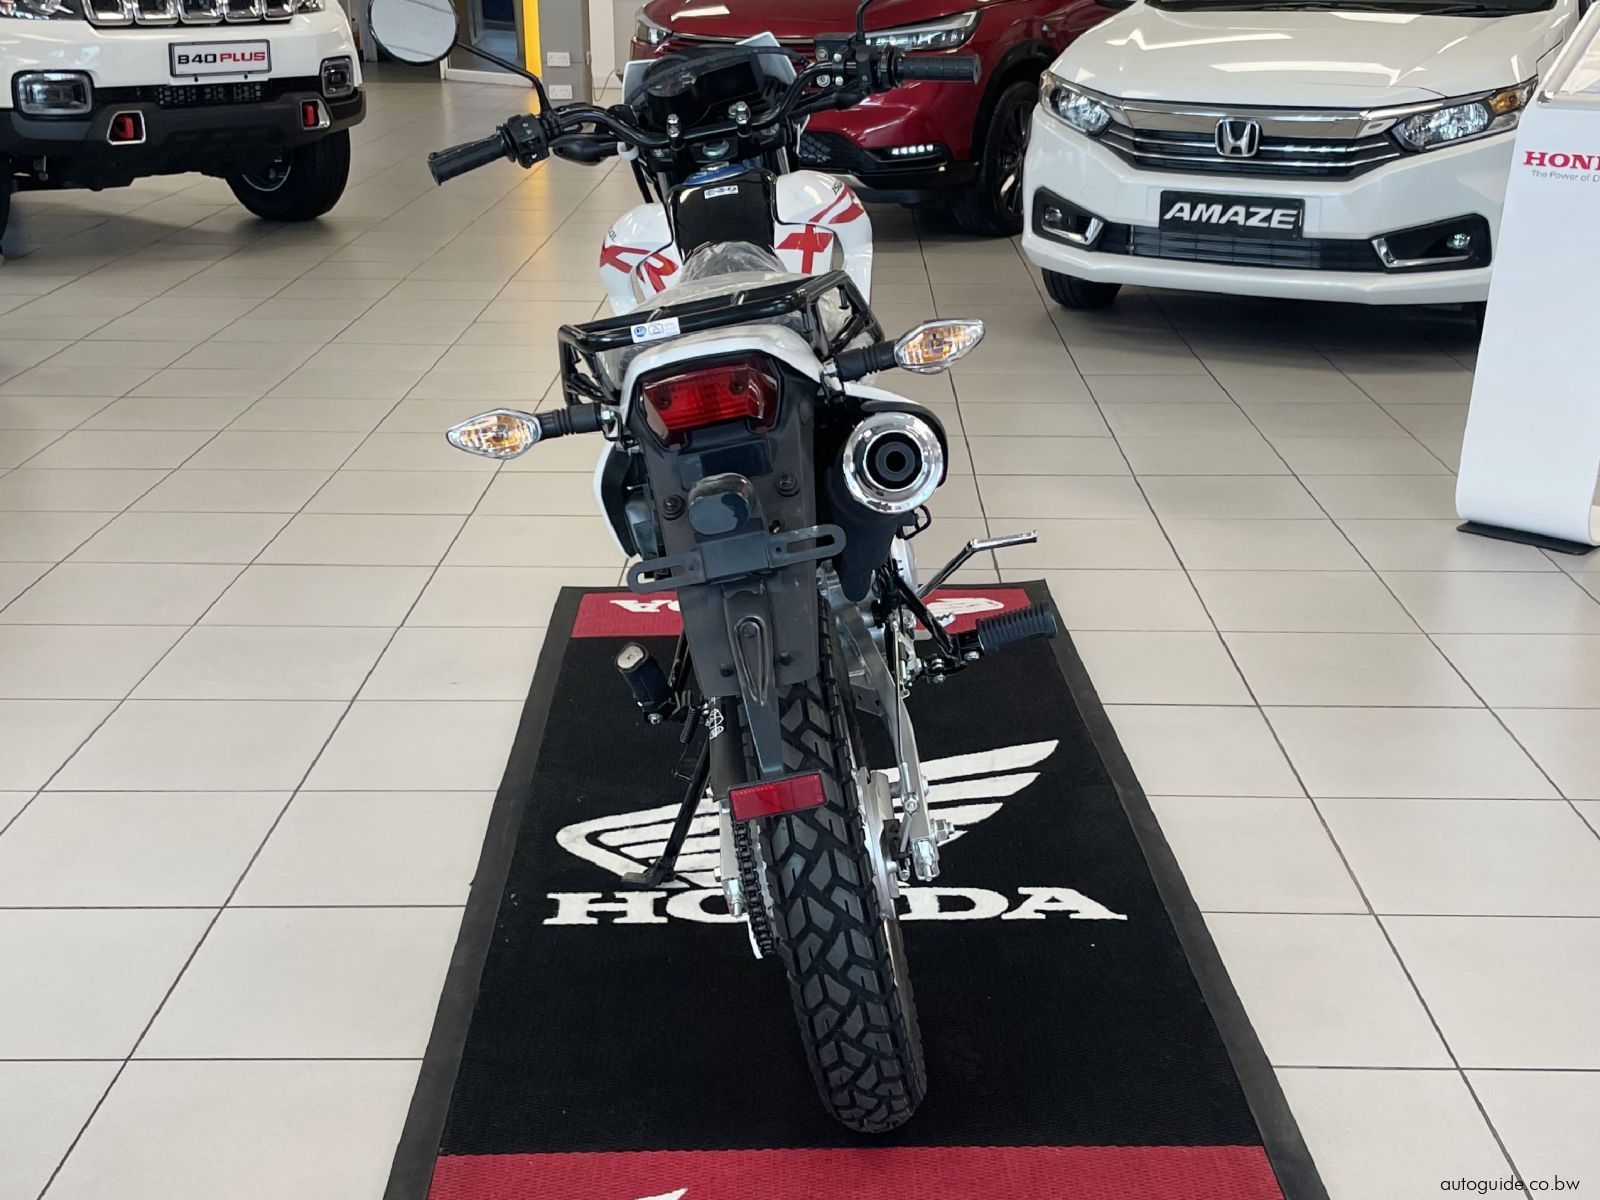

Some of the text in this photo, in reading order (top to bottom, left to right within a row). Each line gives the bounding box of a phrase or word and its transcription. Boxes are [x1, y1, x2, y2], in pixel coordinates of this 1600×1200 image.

[220, 51, 266, 63] PLUS
[1531, 169, 1548, 178] The
[1549, 171, 1579, 181] Power
[1163, 202, 1298, 230] AMAZE
